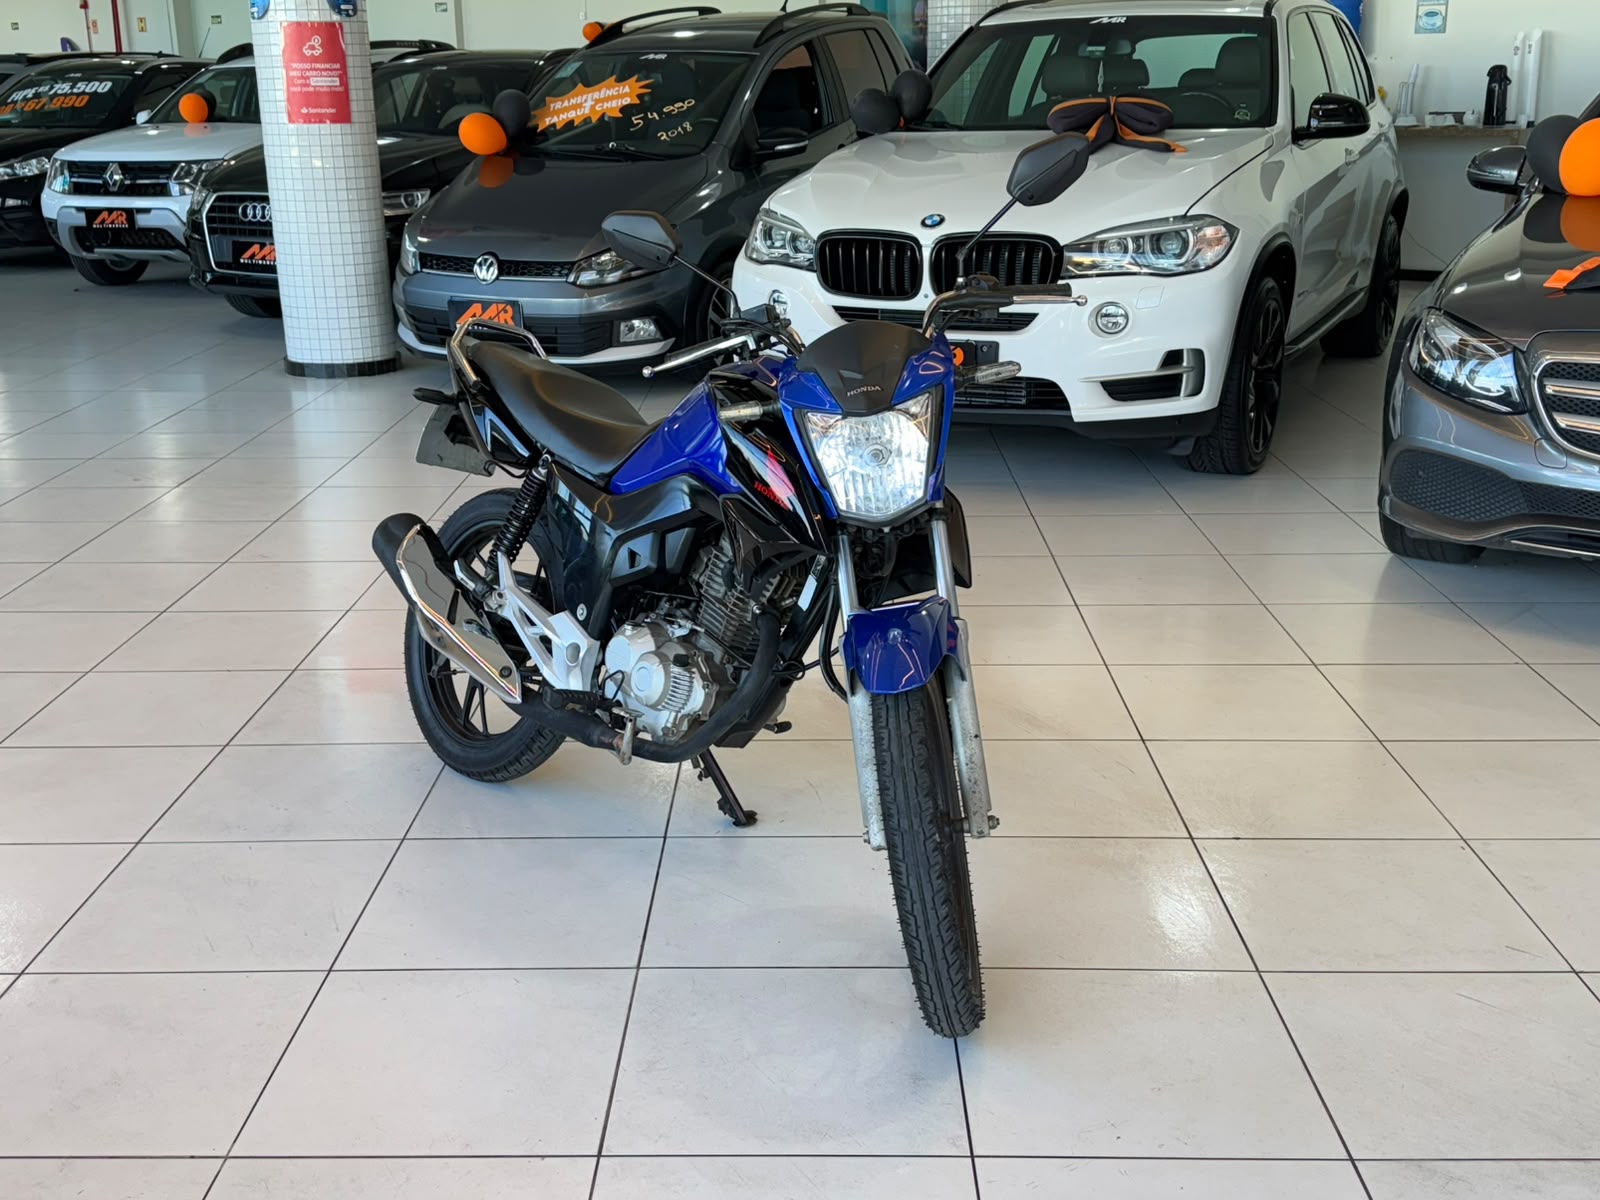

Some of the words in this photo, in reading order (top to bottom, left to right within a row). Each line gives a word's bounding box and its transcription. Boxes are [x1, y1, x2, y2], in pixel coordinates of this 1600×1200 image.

[7, 86, 38, 102] FIPE
[549, 84, 631, 112] TRANSFERÊNCIA
[544, 106, 591, 125] TANQUE
[595, 97, 631, 112] CHEIO
[630, 98, 696, 132] 54.990
[657, 121, 693, 142] 2018
[846, 384, 882, 397] HONDA
[753, 481, 791, 511] HONDA
